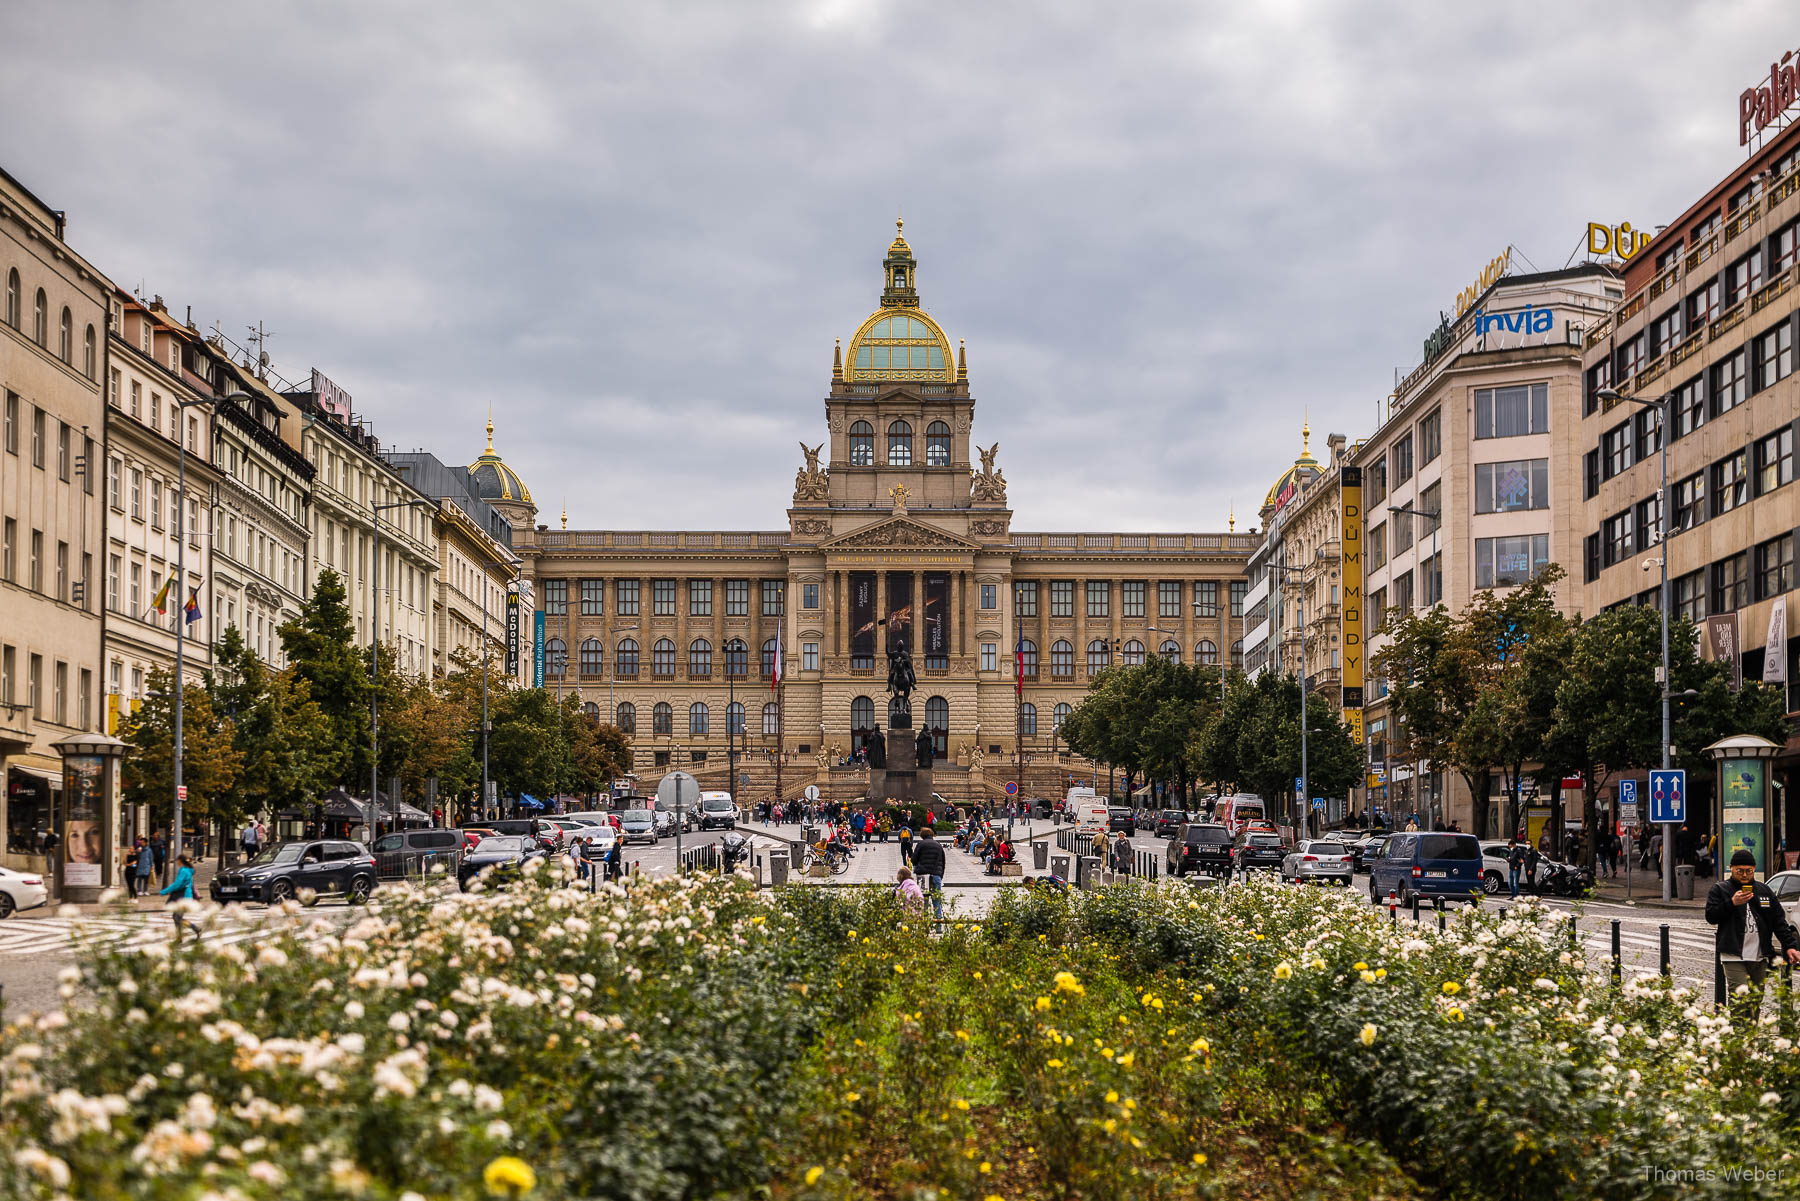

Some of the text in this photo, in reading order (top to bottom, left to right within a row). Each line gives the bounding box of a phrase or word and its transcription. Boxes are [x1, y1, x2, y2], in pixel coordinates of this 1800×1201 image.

[1475, 304, 1553, 337] invia
[1345, 505, 1359, 668] DŮM MÓDY
[509, 607, 518, 676] McDonald's
[1623, 782, 1633, 797] P
